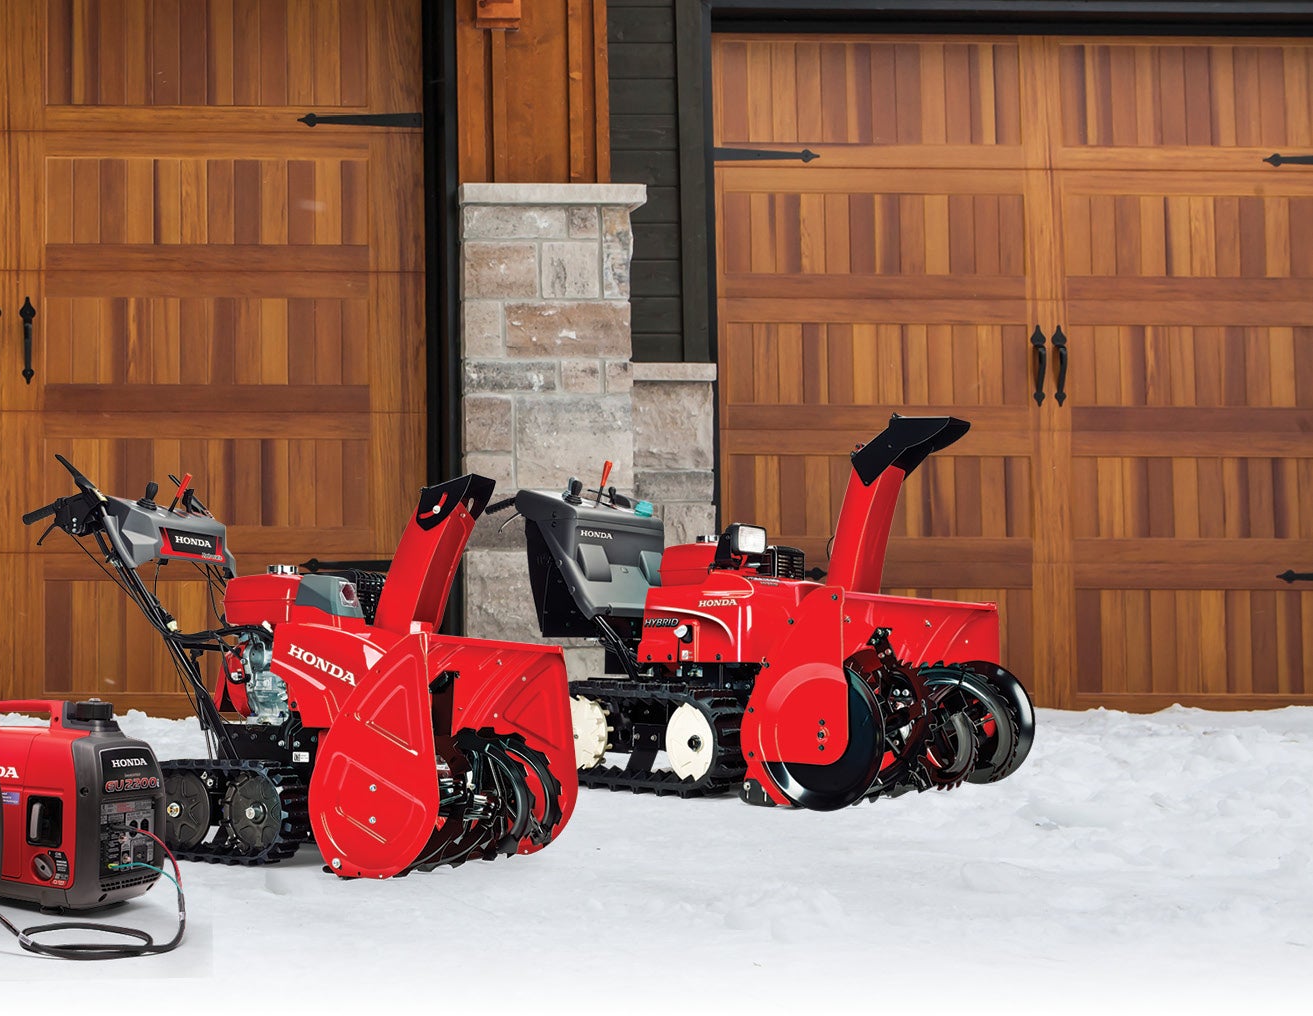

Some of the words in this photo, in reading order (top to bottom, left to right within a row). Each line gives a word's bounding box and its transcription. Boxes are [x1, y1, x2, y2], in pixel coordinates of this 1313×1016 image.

[580, 529, 613, 540] HONDA
[174, 535, 212, 548] HONDA
[697, 599, 738, 608] HONDA
[643, 618, 679, 628] HYBRID
[287, 643, 357, 687] HONDA
[111, 758, 148, 768] HONDA
